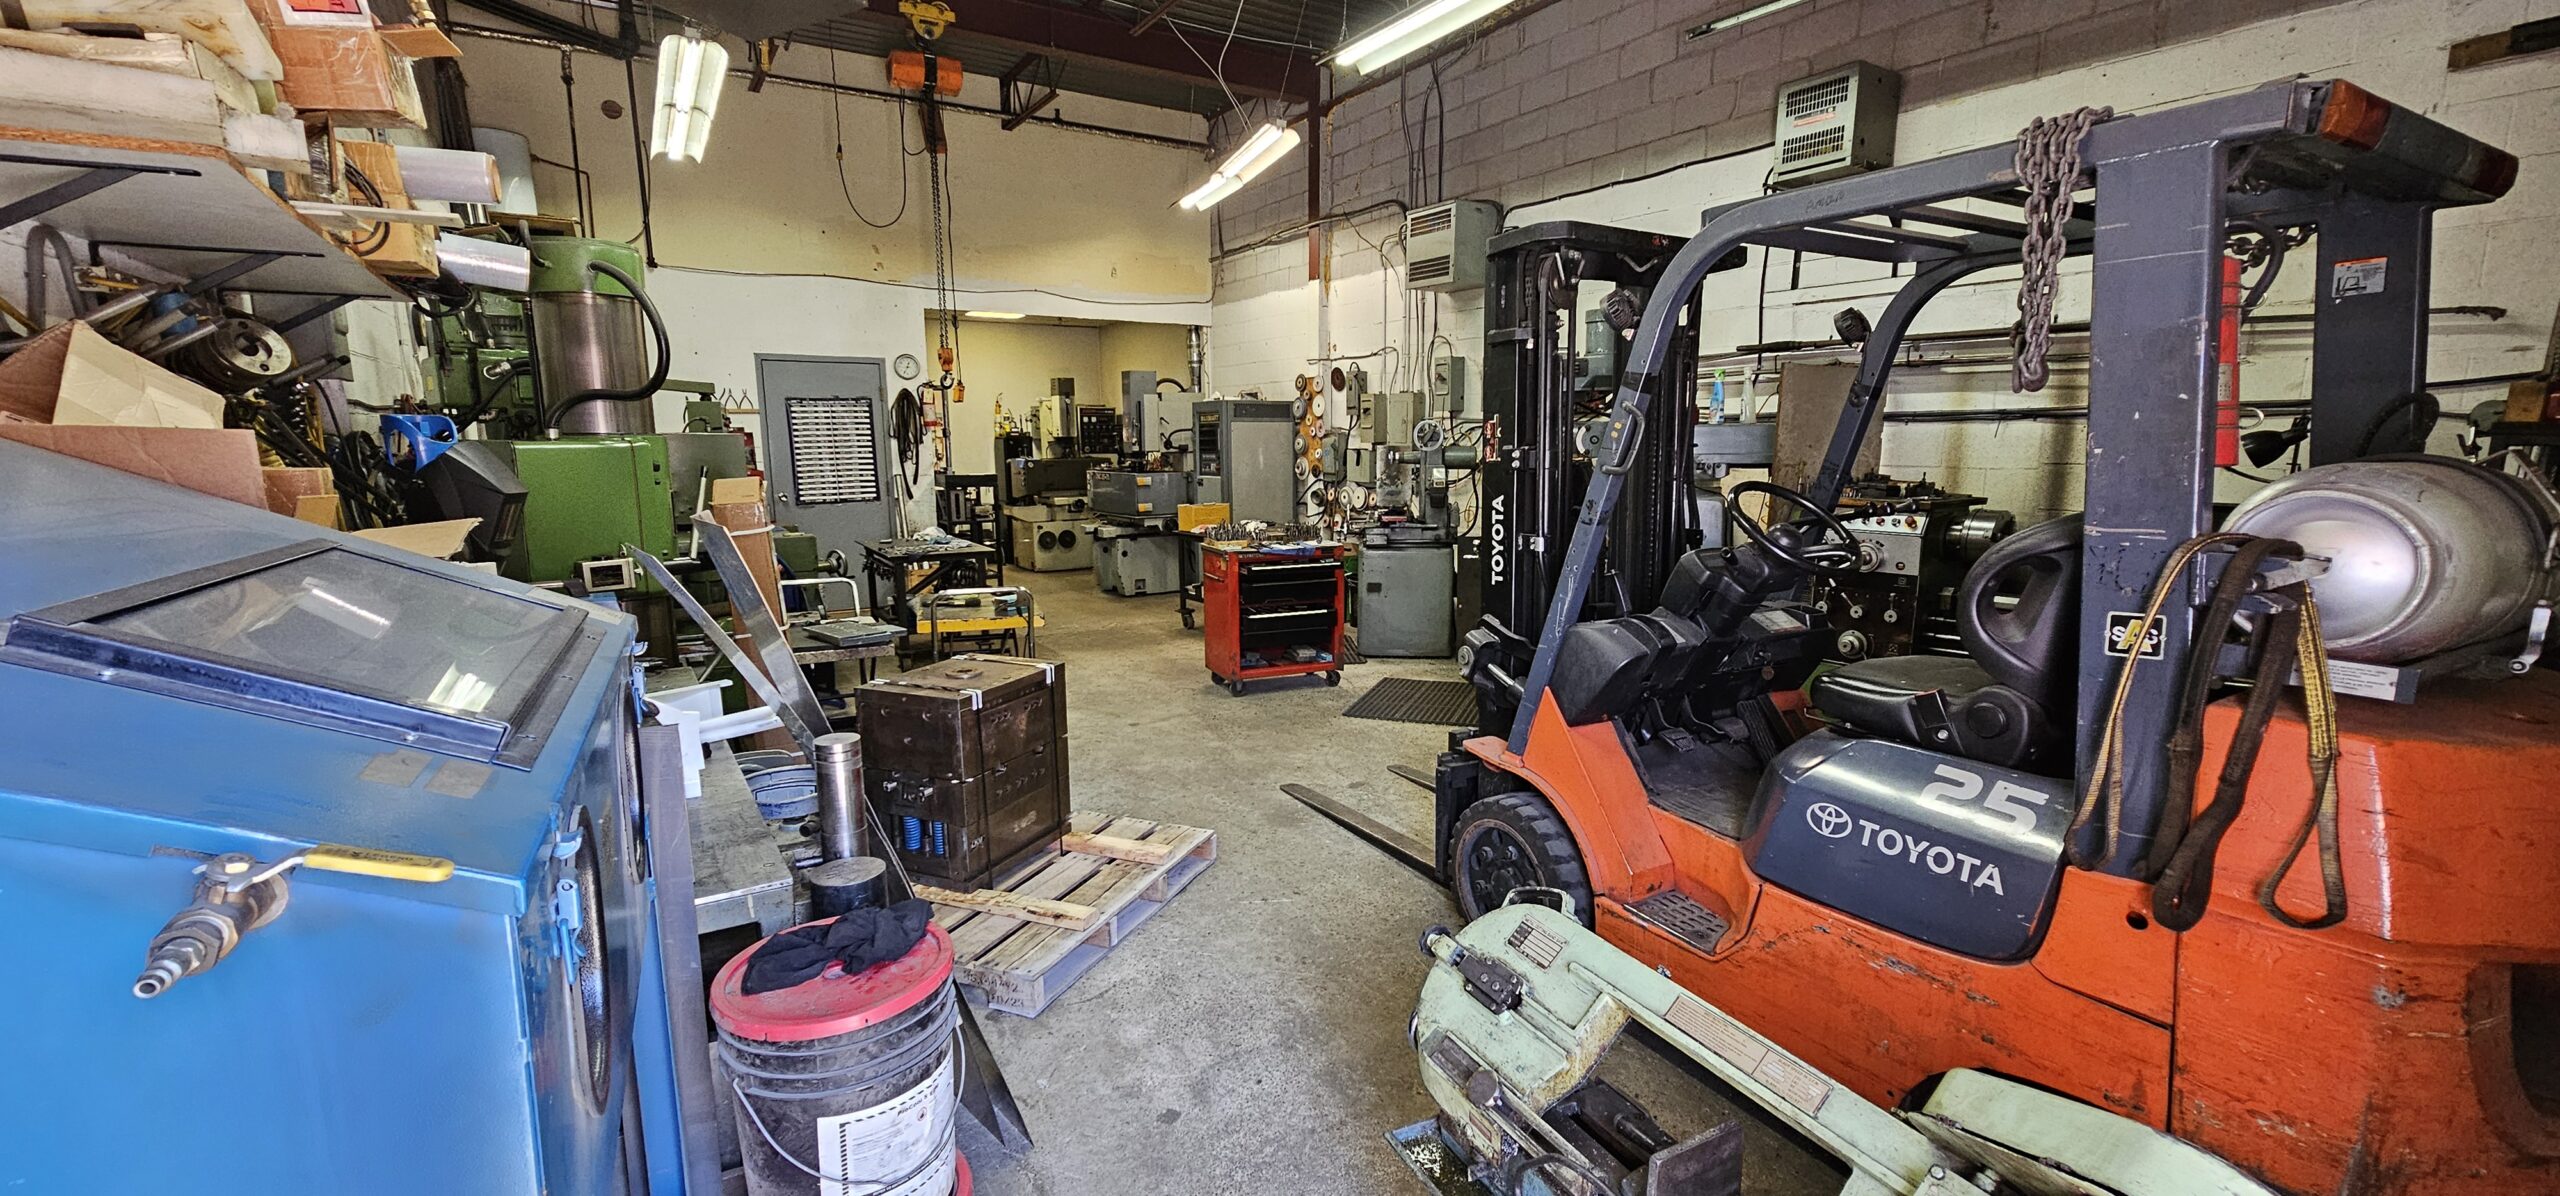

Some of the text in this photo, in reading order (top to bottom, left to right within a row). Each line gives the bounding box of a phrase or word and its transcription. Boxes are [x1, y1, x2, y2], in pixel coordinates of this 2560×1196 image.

[1491, 494, 1504, 585] TOYOTA
[1916, 763, 2049, 834] 25
[1858, 818, 2004, 896] TOYOTA
